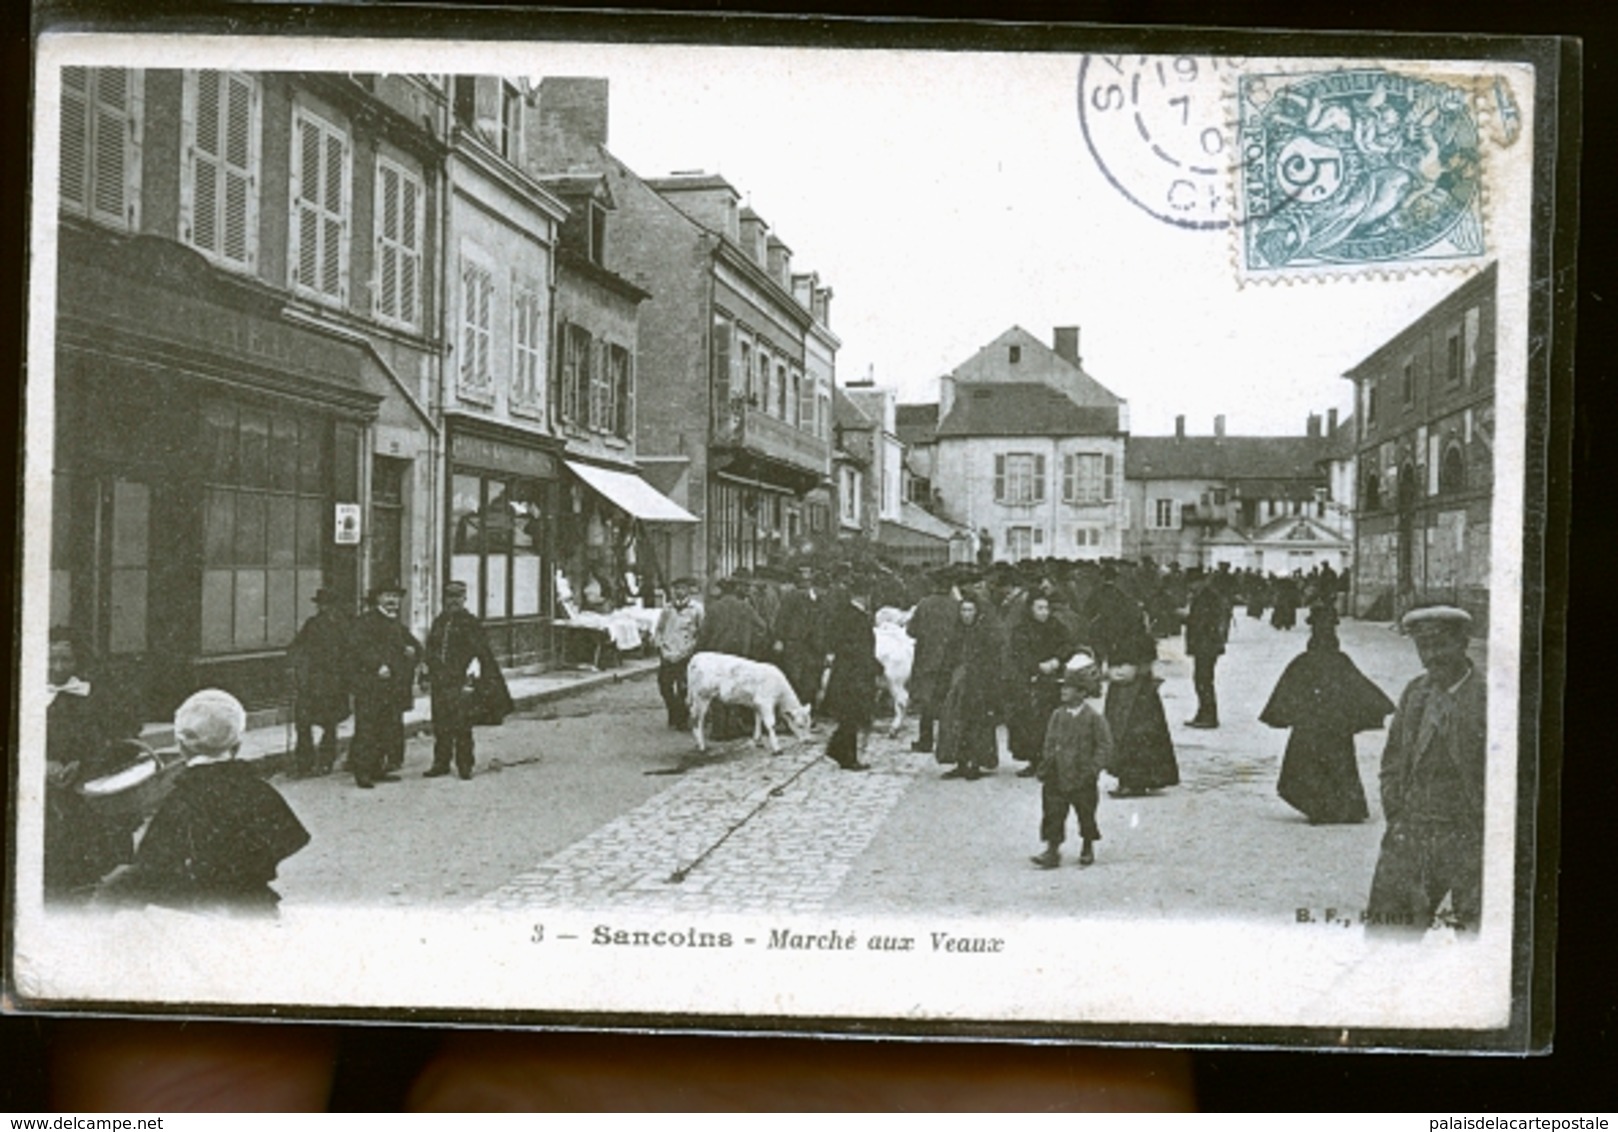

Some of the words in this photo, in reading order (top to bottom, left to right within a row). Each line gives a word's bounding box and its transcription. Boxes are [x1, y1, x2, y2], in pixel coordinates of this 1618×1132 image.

[1243, 129, 1268, 214] POSTES
[531, 923, 545, 943] 3
[592, 924, 733, 948] Sancoins
[767, 929, 857, 950] Marché
[867, 937, 916, 951] aux
[930, 932, 1005, 953] Veaux
